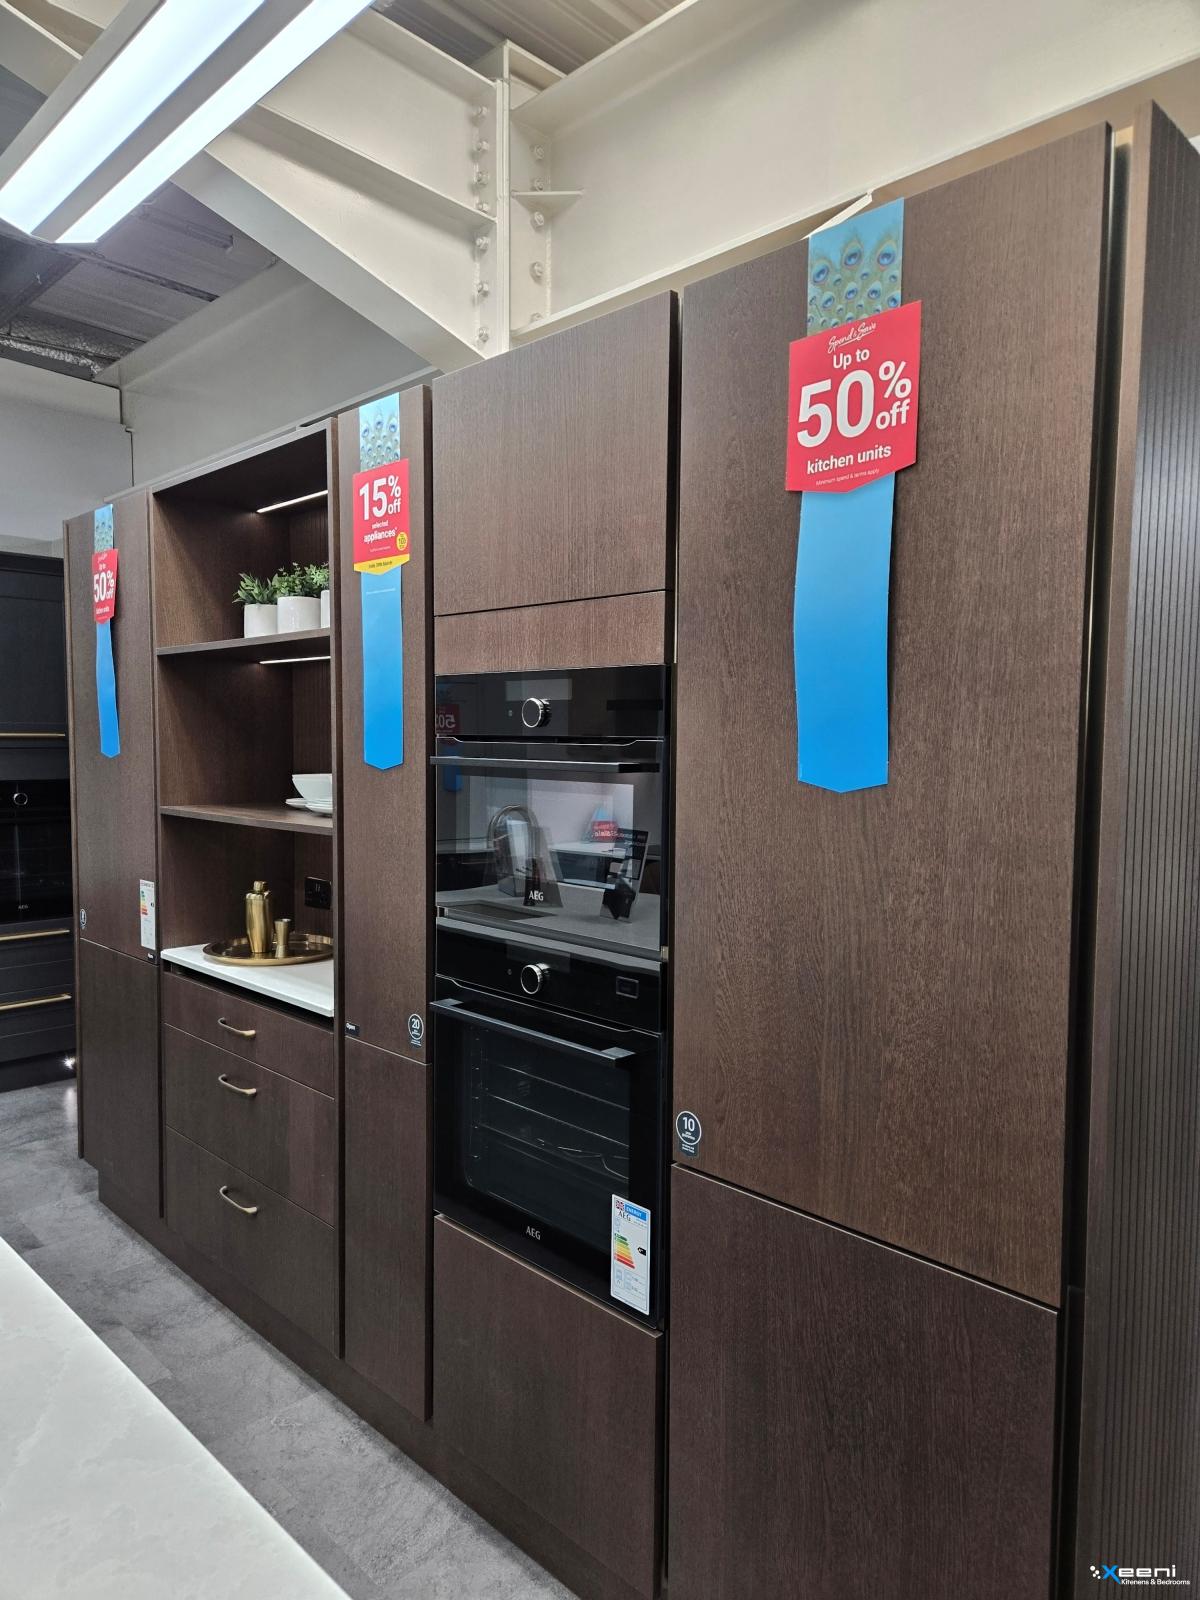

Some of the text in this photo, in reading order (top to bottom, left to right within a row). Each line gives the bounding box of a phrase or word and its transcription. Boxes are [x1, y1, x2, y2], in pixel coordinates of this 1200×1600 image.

[833, 348, 870, 370] Up to
[797, 360, 912, 448] 50% off
[807, 444, 892, 475] kitchen units
[359, 474, 402, 520] 15% off
[93, 570, 115, 603] 50%
[528, 890, 544, 901] AEG
[411, 1018, 420, 1030] 20
[682, 1116, 696, 1132] 10
[525, 1225, 541, 1241] AEG
